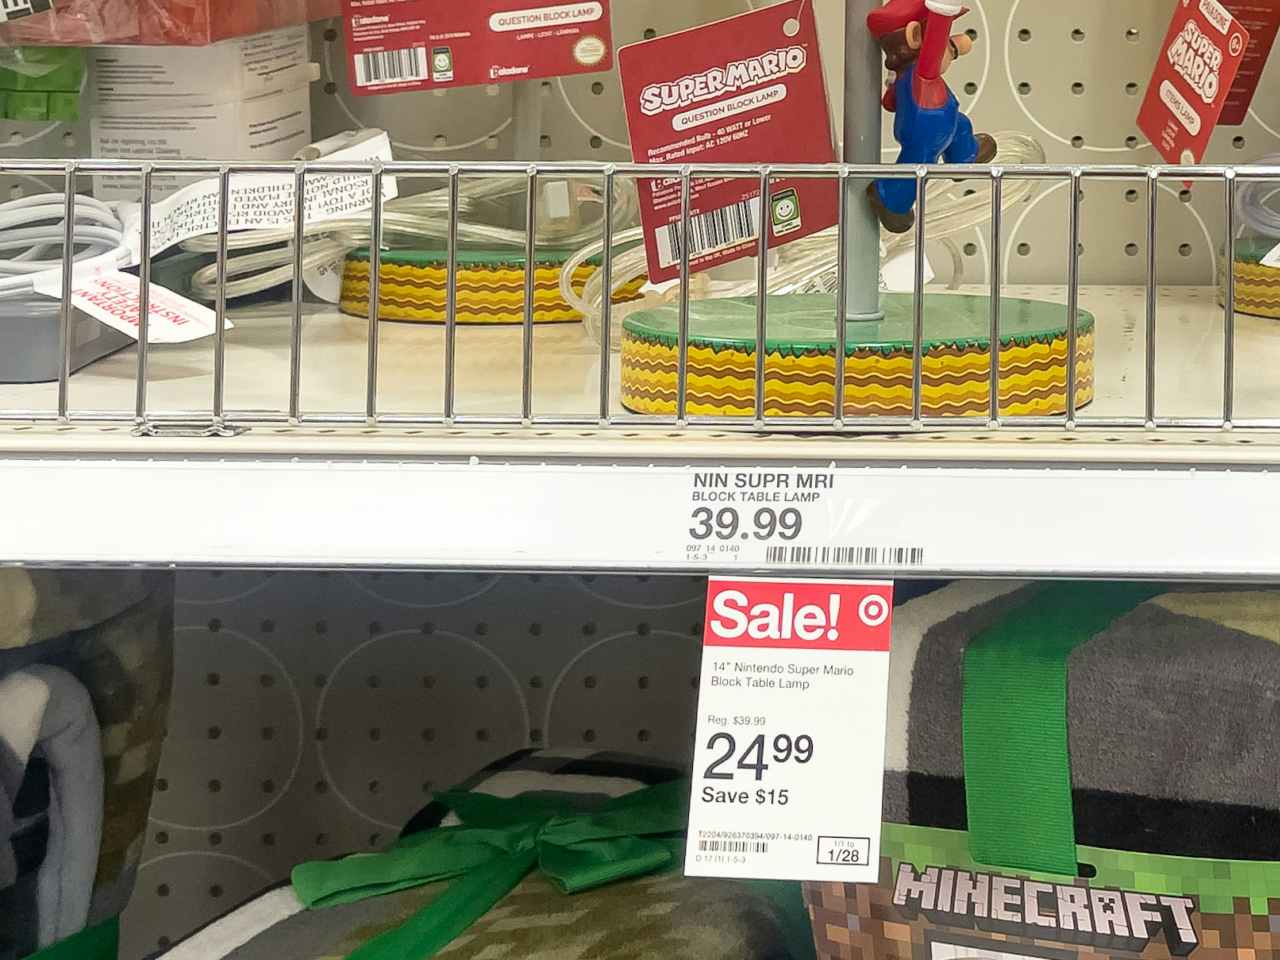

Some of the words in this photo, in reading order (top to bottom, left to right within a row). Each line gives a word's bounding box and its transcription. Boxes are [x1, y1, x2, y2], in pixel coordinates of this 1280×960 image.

[498, 15, 541, 26] QUESTION
[543, 10, 571, 21] BLOCK
[572, 7, 595, 18] LAMP
[1183, 19, 1223, 71] SUPER
[1167, 33, 1219, 103] MARIO
[640, 66, 728, 116] SUPER
[724, 45, 807, 92] MARIO
[681, 106, 726, 125] QUESTION
[727, 97, 755, 114] BLOCK
[756, 90, 781, 107] LAMP
[693, 473, 728, 488] NIN
[734, 473, 790, 489] SUPR
[796, 473, 835, 489] MRI
[691, 491, 737, 502] BLOCK
[740, 491, 781, 502] TABLE
[784, 492, 821, 502] LAMP
[689, 506, 802, 541] 39.99
[709, 589, 841, 641] Sale!
[734, 662, 784, 674] Nintendo
[788, 664, 820, 676] Super
[823, 665, 854, 676] Mario
[711, 676, 742, 688] Block
[746, 677, 775, 688] Table
[779, 679, 810, 691] Lamp
[707, 715, 729, 726] Reg.
[733, 716, 766, 726] $39.99
[701, 786, 749, 804] Save
[755, 788, 789, 806] $15
[828, 849, 860, 863] 1/28
[892, 863, 1199, 944] MINECRAFT
